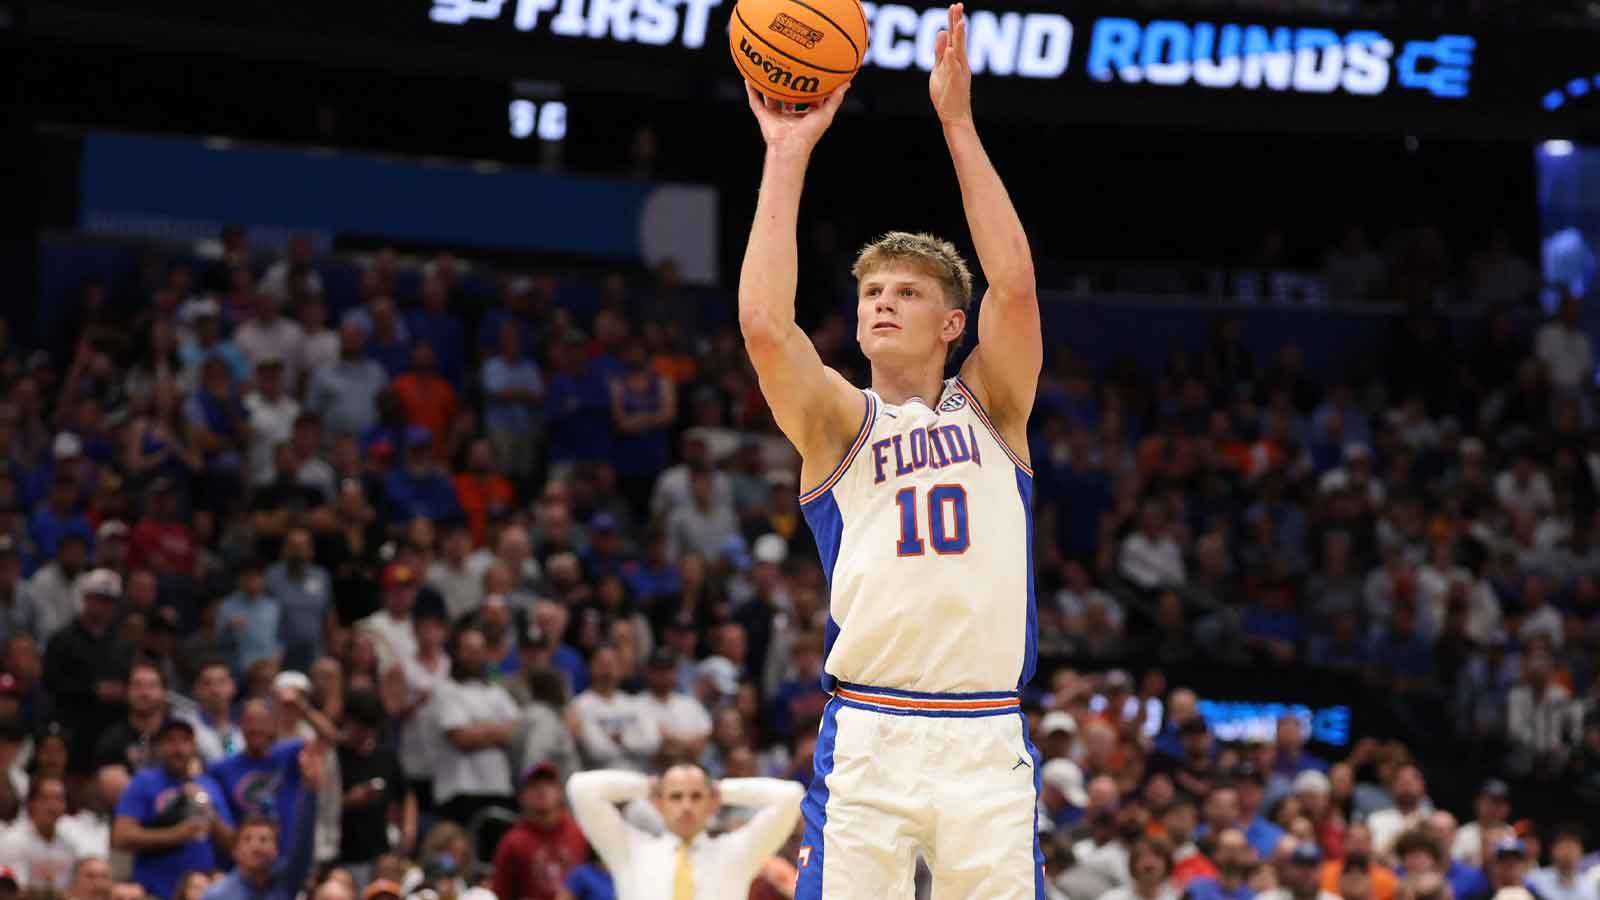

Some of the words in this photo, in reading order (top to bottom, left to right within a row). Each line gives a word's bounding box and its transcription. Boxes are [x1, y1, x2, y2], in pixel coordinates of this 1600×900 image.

[739, 35, 820, 93] Wilson
[862, 2, 1074, 79] COND
[1087, 16, 1394, 95] ROUNDS
[872, 424, 982, 485] FLOID
[895, 483, 971, 557] 10
